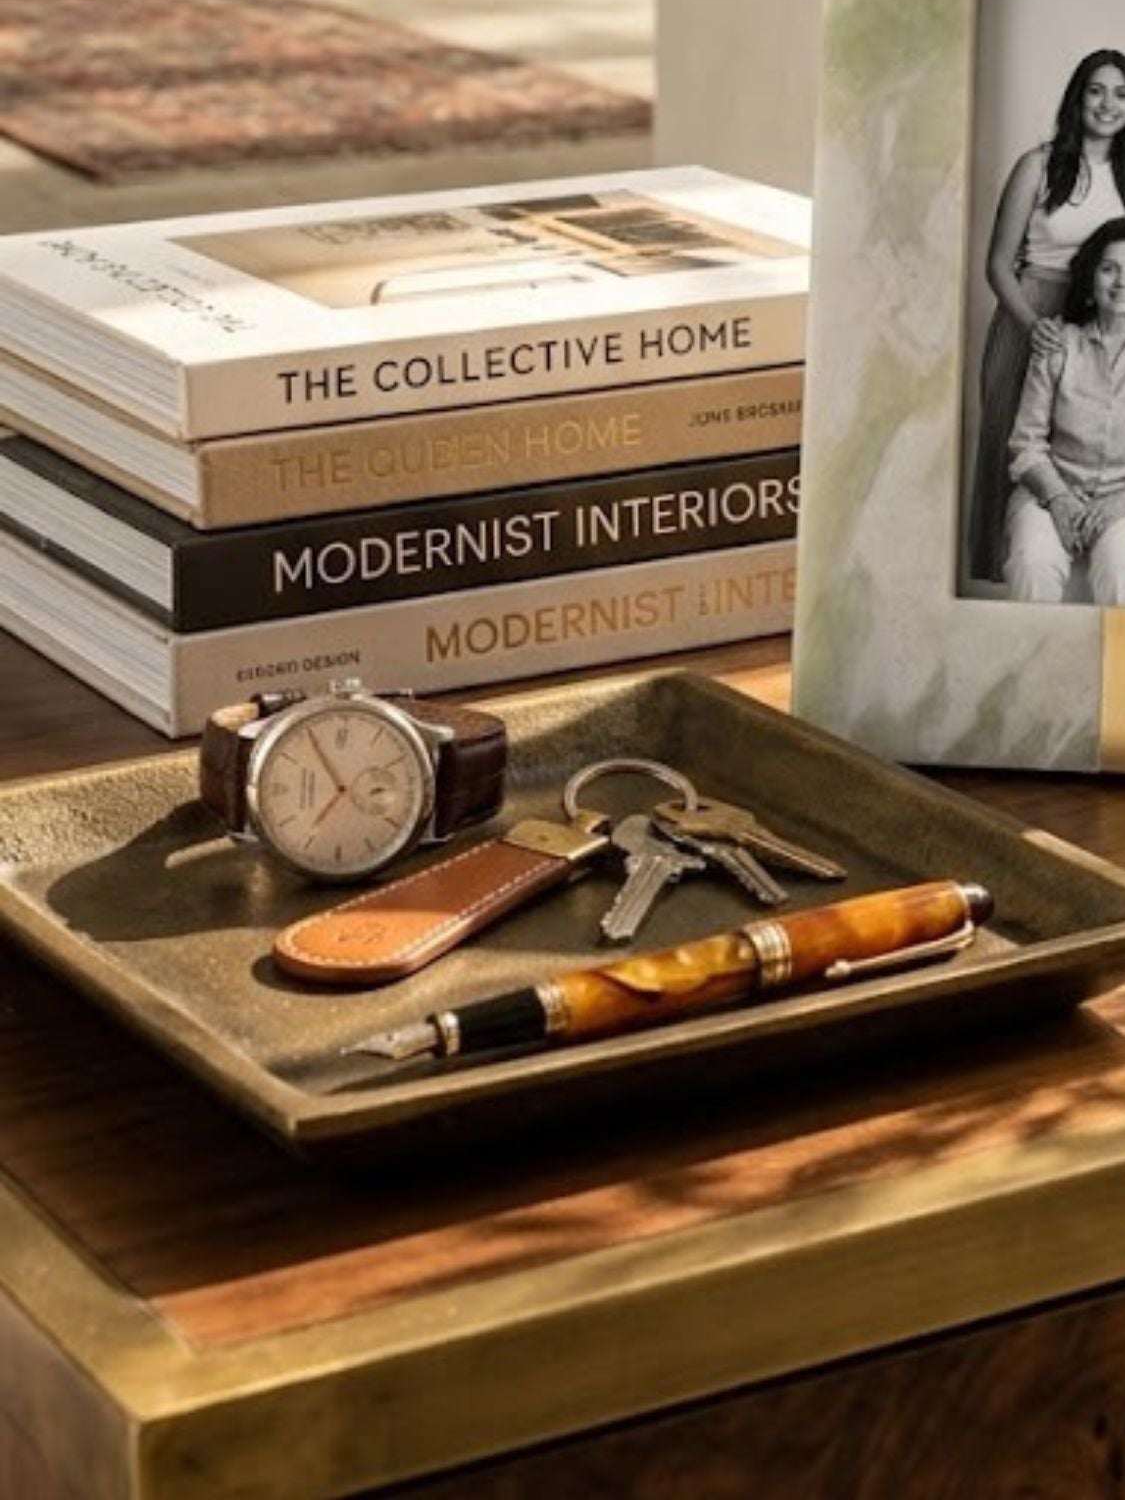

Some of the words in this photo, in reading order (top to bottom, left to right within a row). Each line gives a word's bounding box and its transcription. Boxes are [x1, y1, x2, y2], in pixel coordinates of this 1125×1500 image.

[277, 364, 357, 403] THE
[373, 332, 623, 392] COLLECTIVE
[639, 317, 752, 360] HOME
[270, 449, 352, 492] THE
[523, 413, 643, 459] HOME
[274, 511, 560, 593] MODERNIST
[425, 585, 685, 663] MODERNIST
